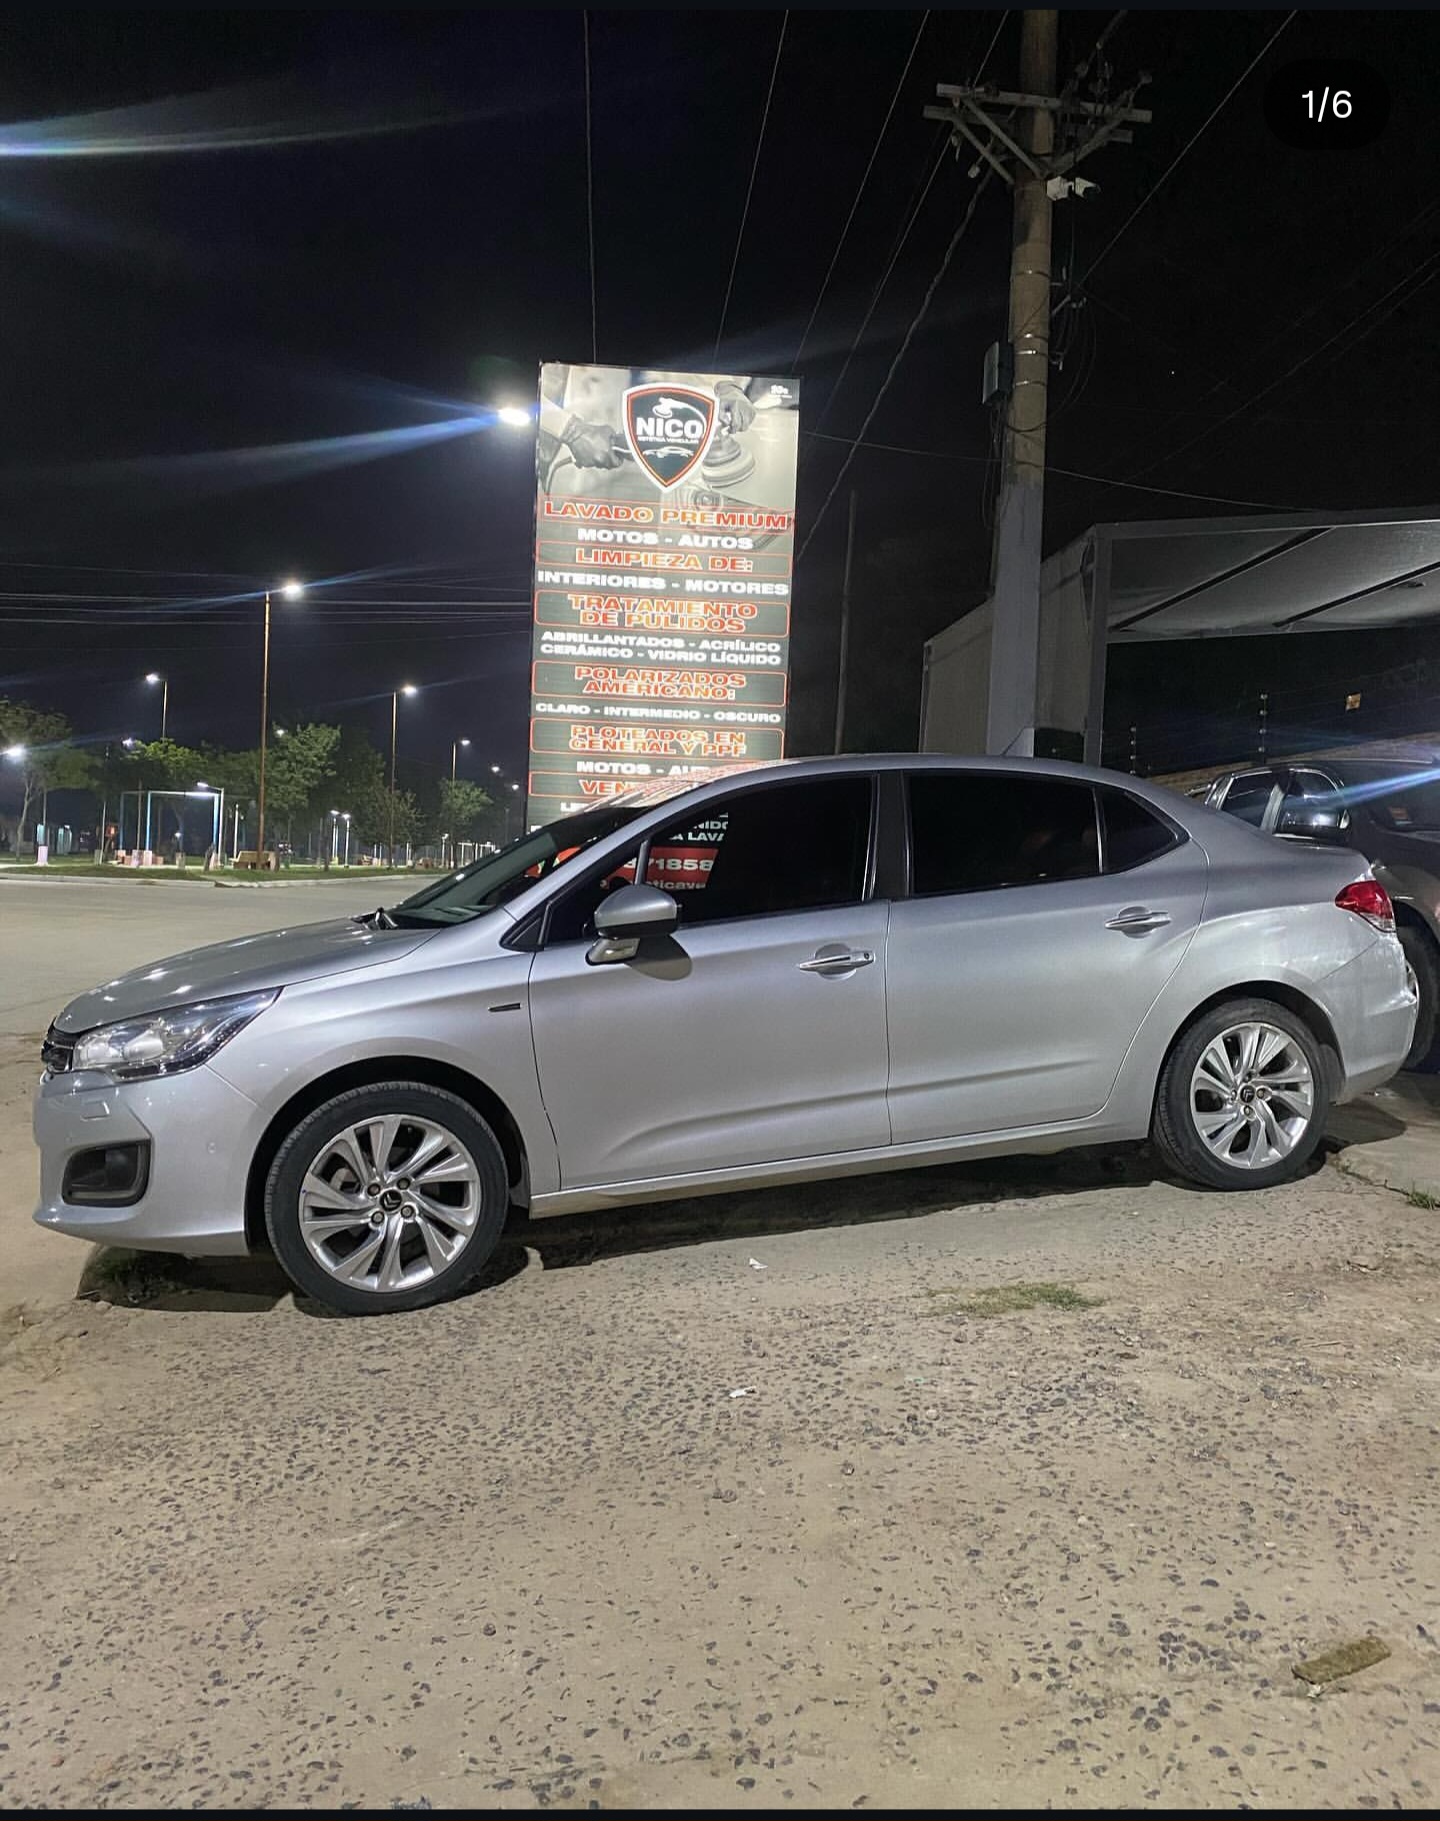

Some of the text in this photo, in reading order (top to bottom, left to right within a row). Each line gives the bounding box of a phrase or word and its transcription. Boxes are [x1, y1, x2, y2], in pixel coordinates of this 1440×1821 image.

[636, 417, 703, 439] NICO
[545, 501, 787, 530] LAVADO PREMIUM
[577, 528, 658, 545] MOTOS
[678, 535, 753, 549] AUTOS
[575, 548, 753, 573] LIMPIEZA DE:
[537, 570, 666, 589] INTERIORES
[685, 579, 788, 595] MOTORES
[568, 594, 757, 619] TRATAMIENTO
[580, 610, 746, 632] DE PULIDOS
[541, 631, 685, 648] ABRILLANTADOS
[699, 639, 780, 652] ACRÍLICO
[540, 644, 633, 658] CERÁMICO
[648, 649, 706, 662] VIDRIO
[711, 651, 781, 665] LÍQUIDO
[575, 666, 746, 687] POLARIZADOS
[583, 681, 735, 700] AMERICANO:
[536, 703, 591, 714] CLARO
[604, 706, 700, 720] INTERMEDIO
[713, 711, 781, 723] OSCURO
[570, 725, 745, 744] PLOTEADOS EN
[569, 738, 747, 757] GENERAL Y PPF
[576, 761, 650, 775] MOTOS
